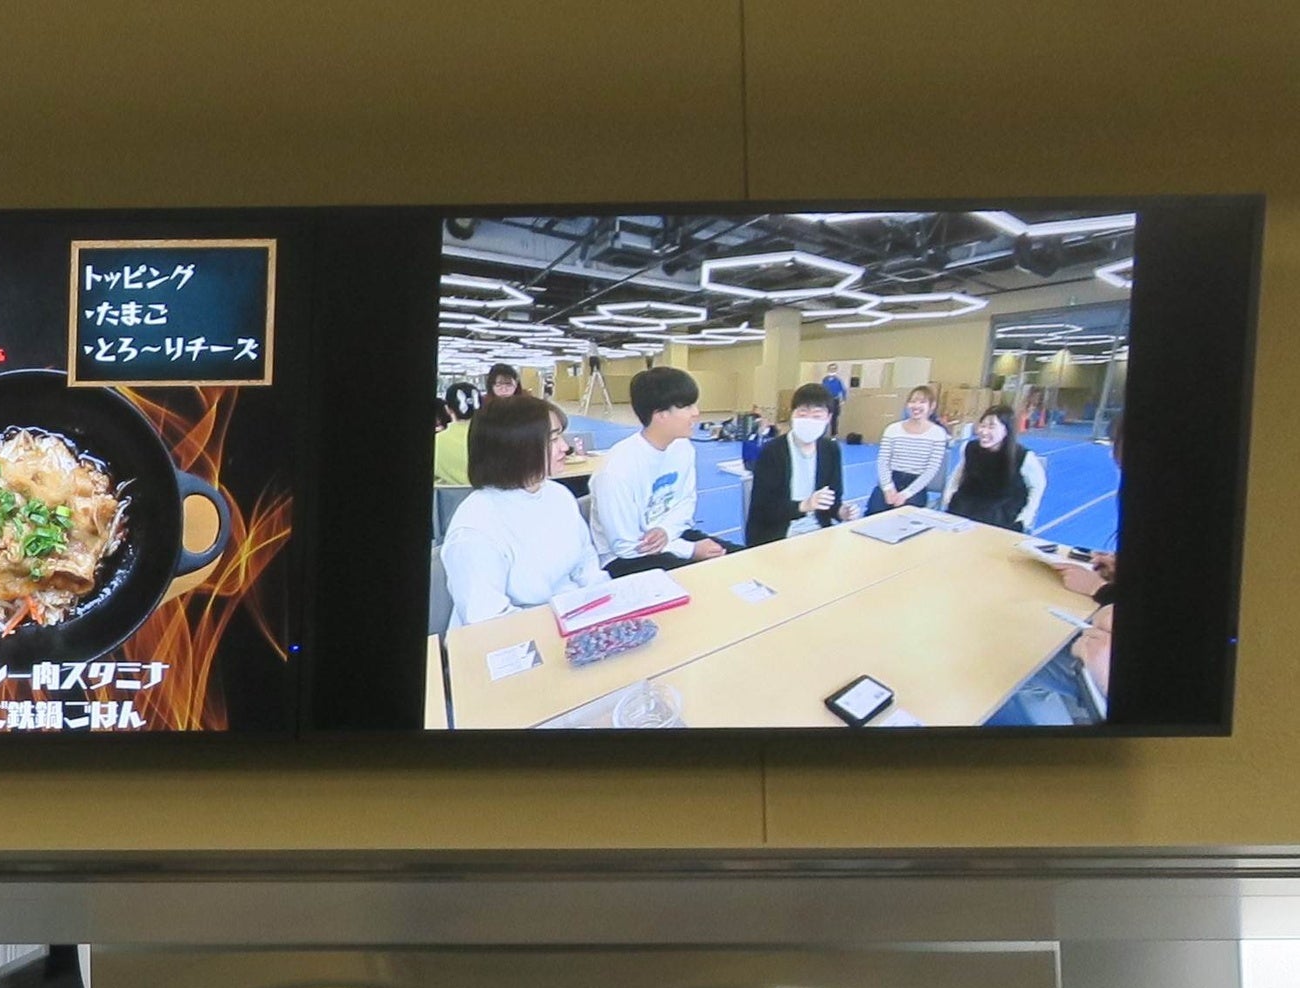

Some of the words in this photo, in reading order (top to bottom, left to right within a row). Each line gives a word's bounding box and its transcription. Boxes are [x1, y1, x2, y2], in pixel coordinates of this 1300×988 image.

[85, 264, 195, 290] トッピング
